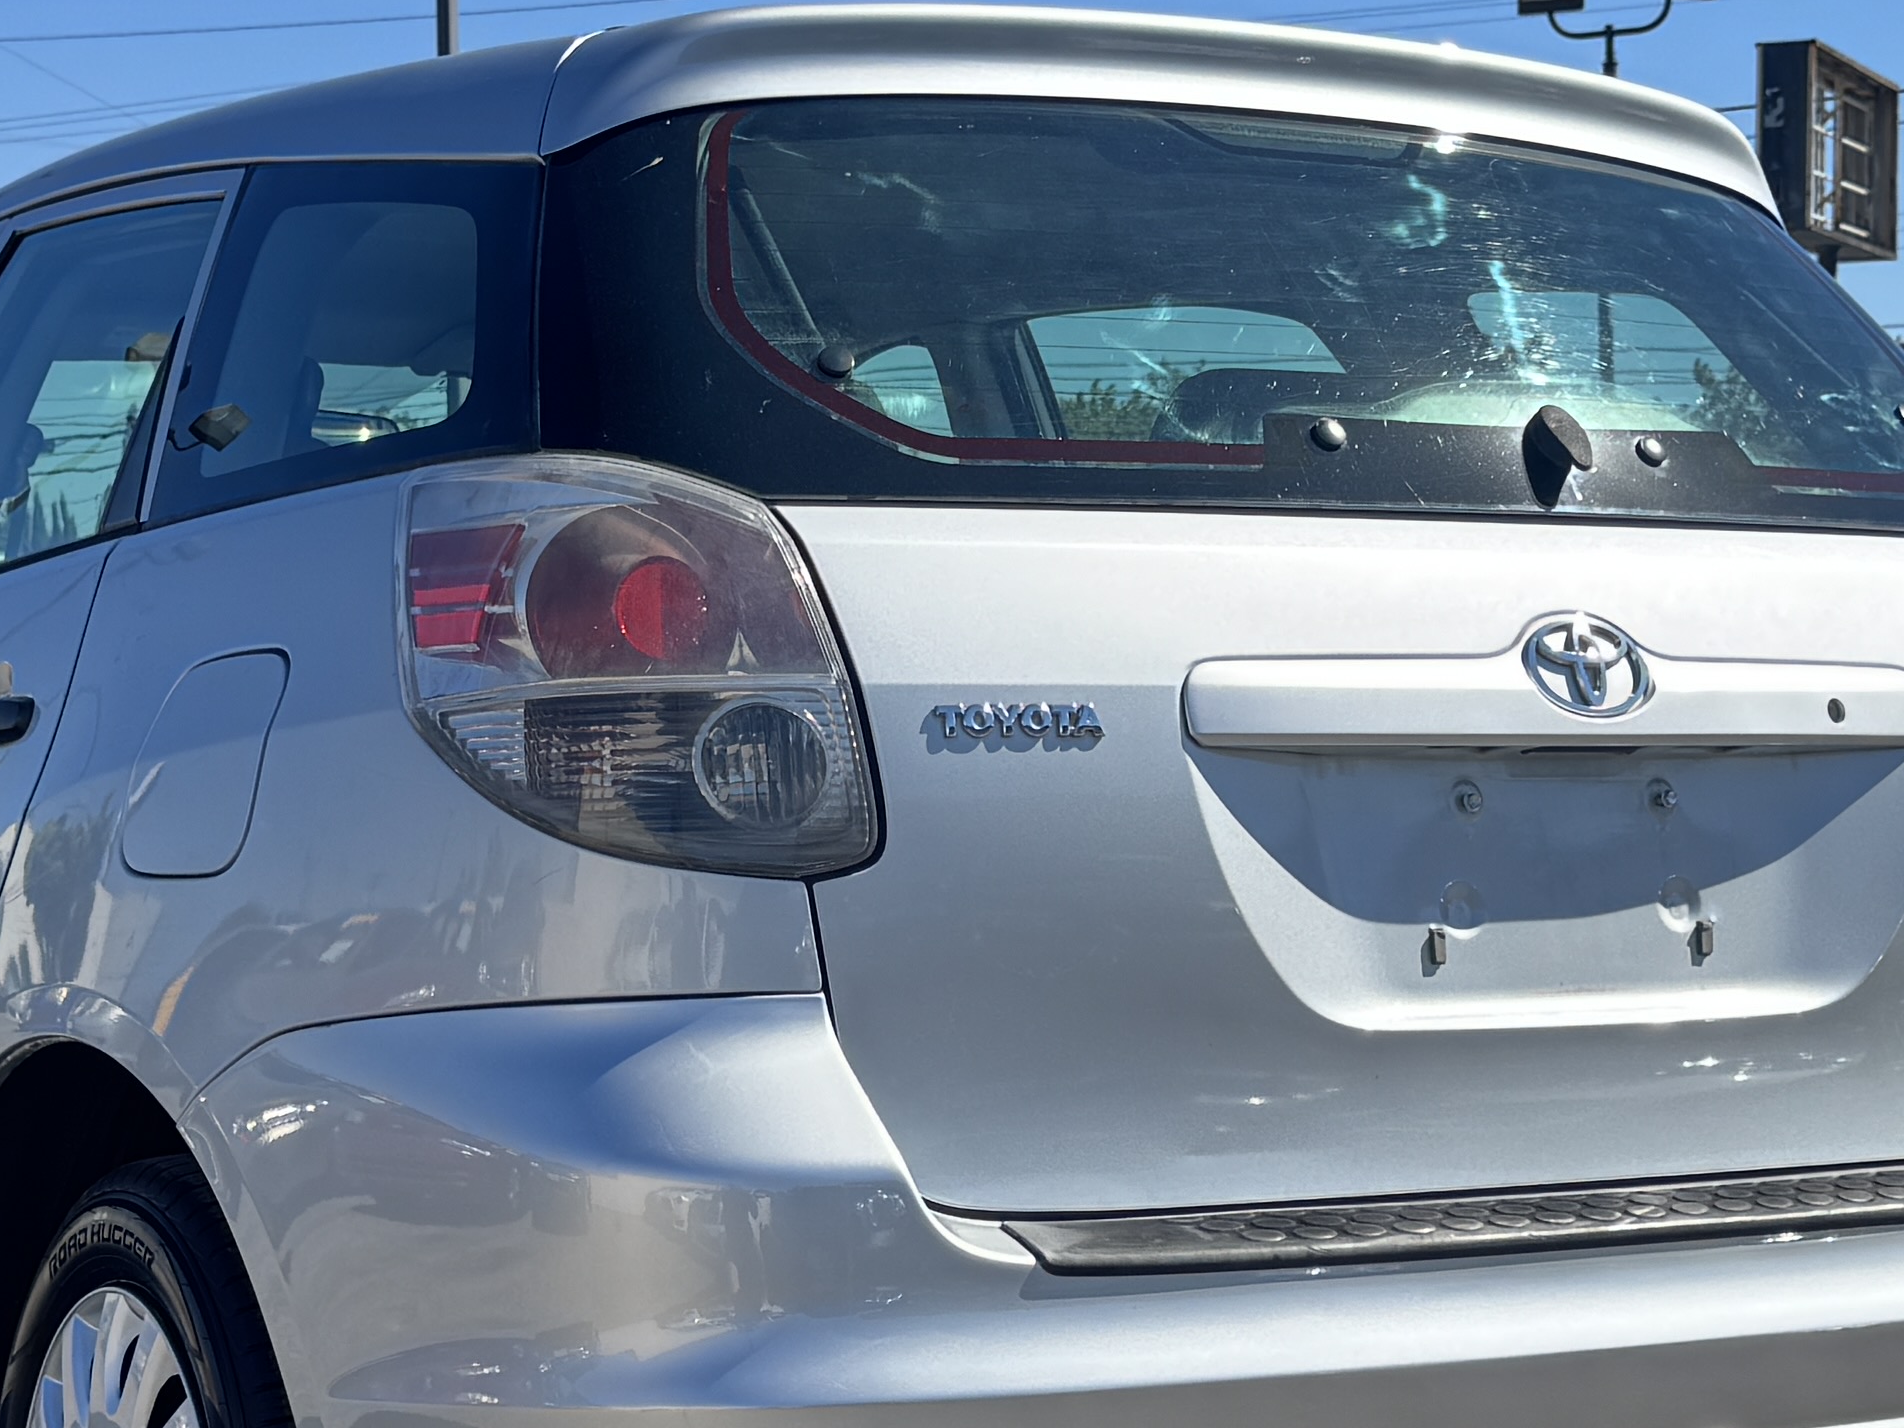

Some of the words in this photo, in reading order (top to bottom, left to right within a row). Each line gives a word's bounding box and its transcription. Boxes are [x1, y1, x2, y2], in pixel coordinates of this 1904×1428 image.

[934, 701, 1105, 738] TOYOTA
[49, 1227, 88, 1280] ROAD
[91, 1223, 155, 1271] HUGGER
